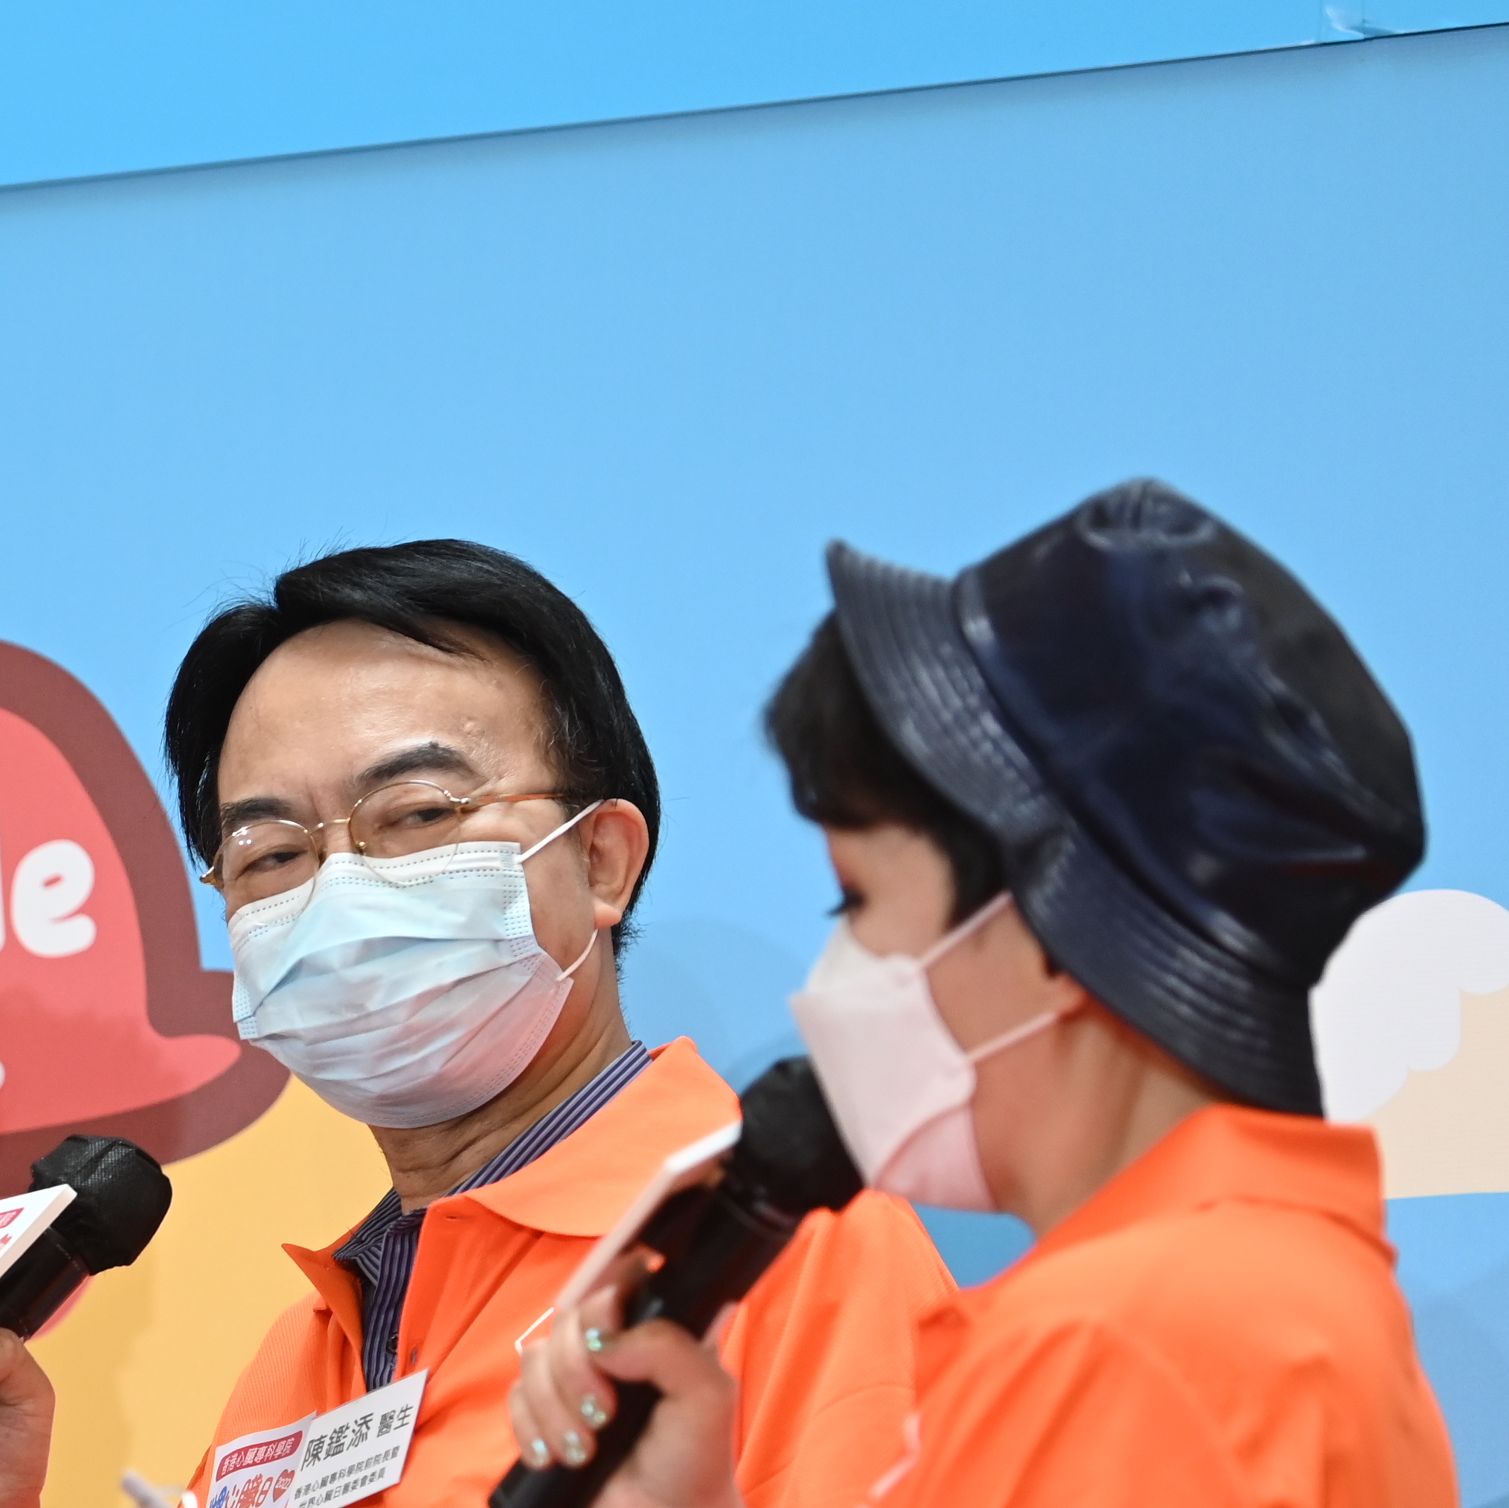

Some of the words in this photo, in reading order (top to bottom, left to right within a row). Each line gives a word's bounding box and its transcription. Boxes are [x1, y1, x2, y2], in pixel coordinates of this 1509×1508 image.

[222, 1437, 295, 1476] 香港心臟專科學院
[300, 1412, 374, 1472] 陳鑑添
[377, 1404, 414, 1439] 醫生
